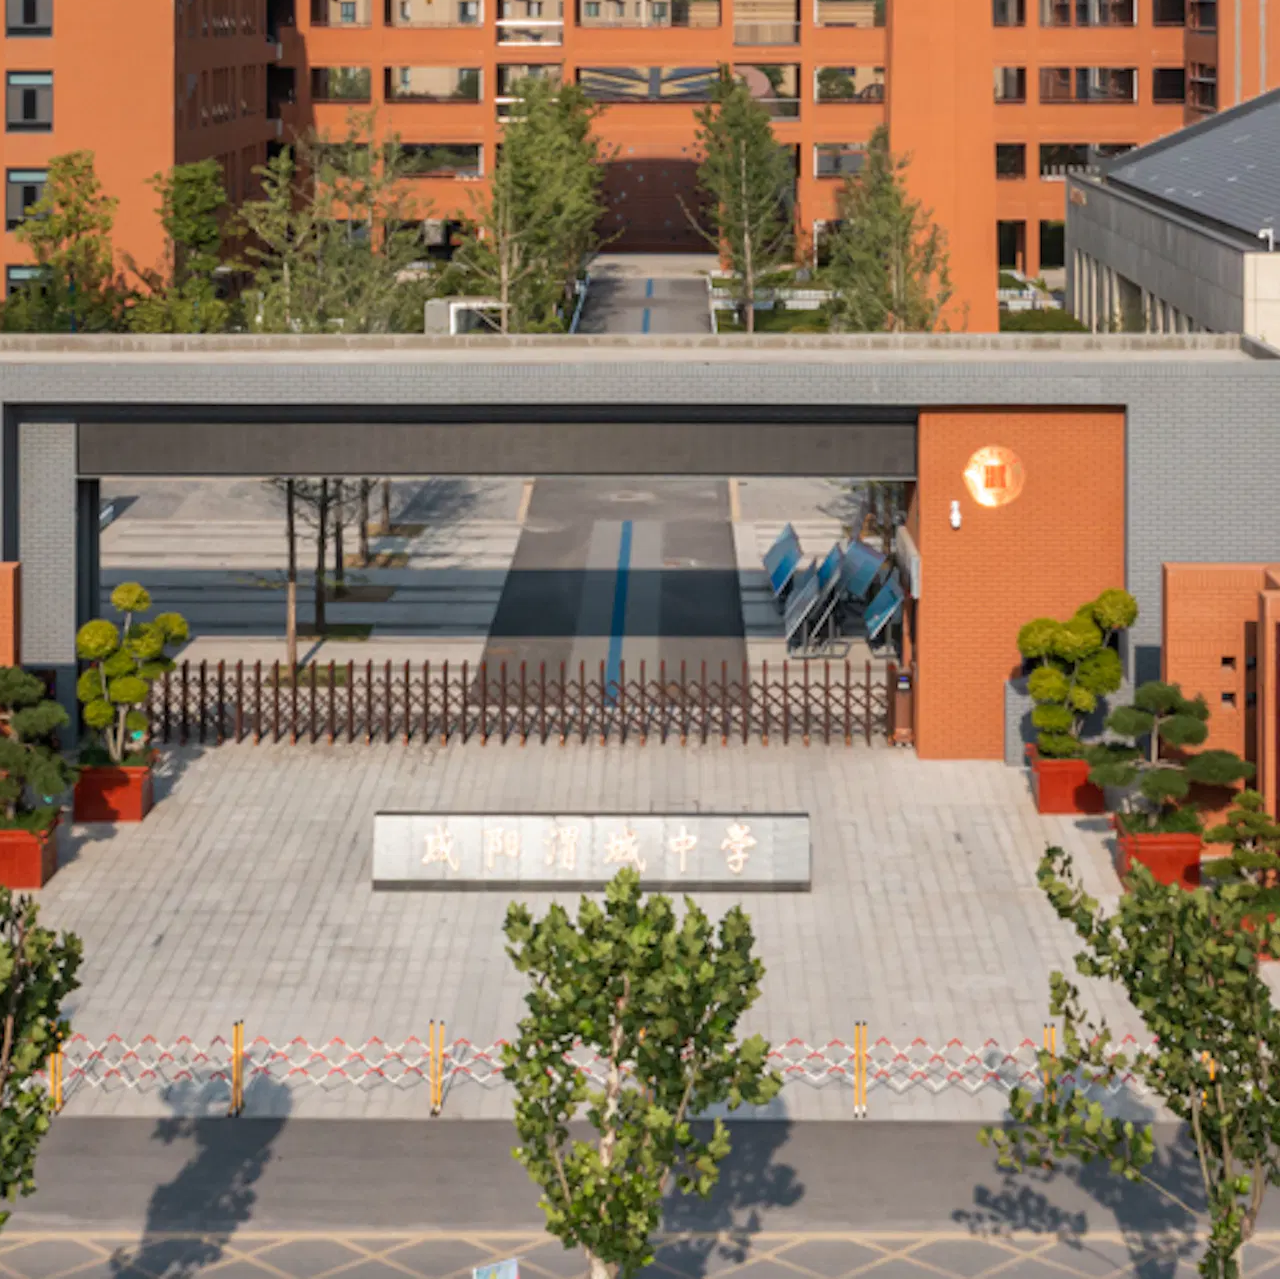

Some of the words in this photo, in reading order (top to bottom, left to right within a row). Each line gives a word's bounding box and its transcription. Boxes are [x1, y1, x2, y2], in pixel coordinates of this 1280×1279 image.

[421, 823, 758, 874] 咸阳渭城中学
